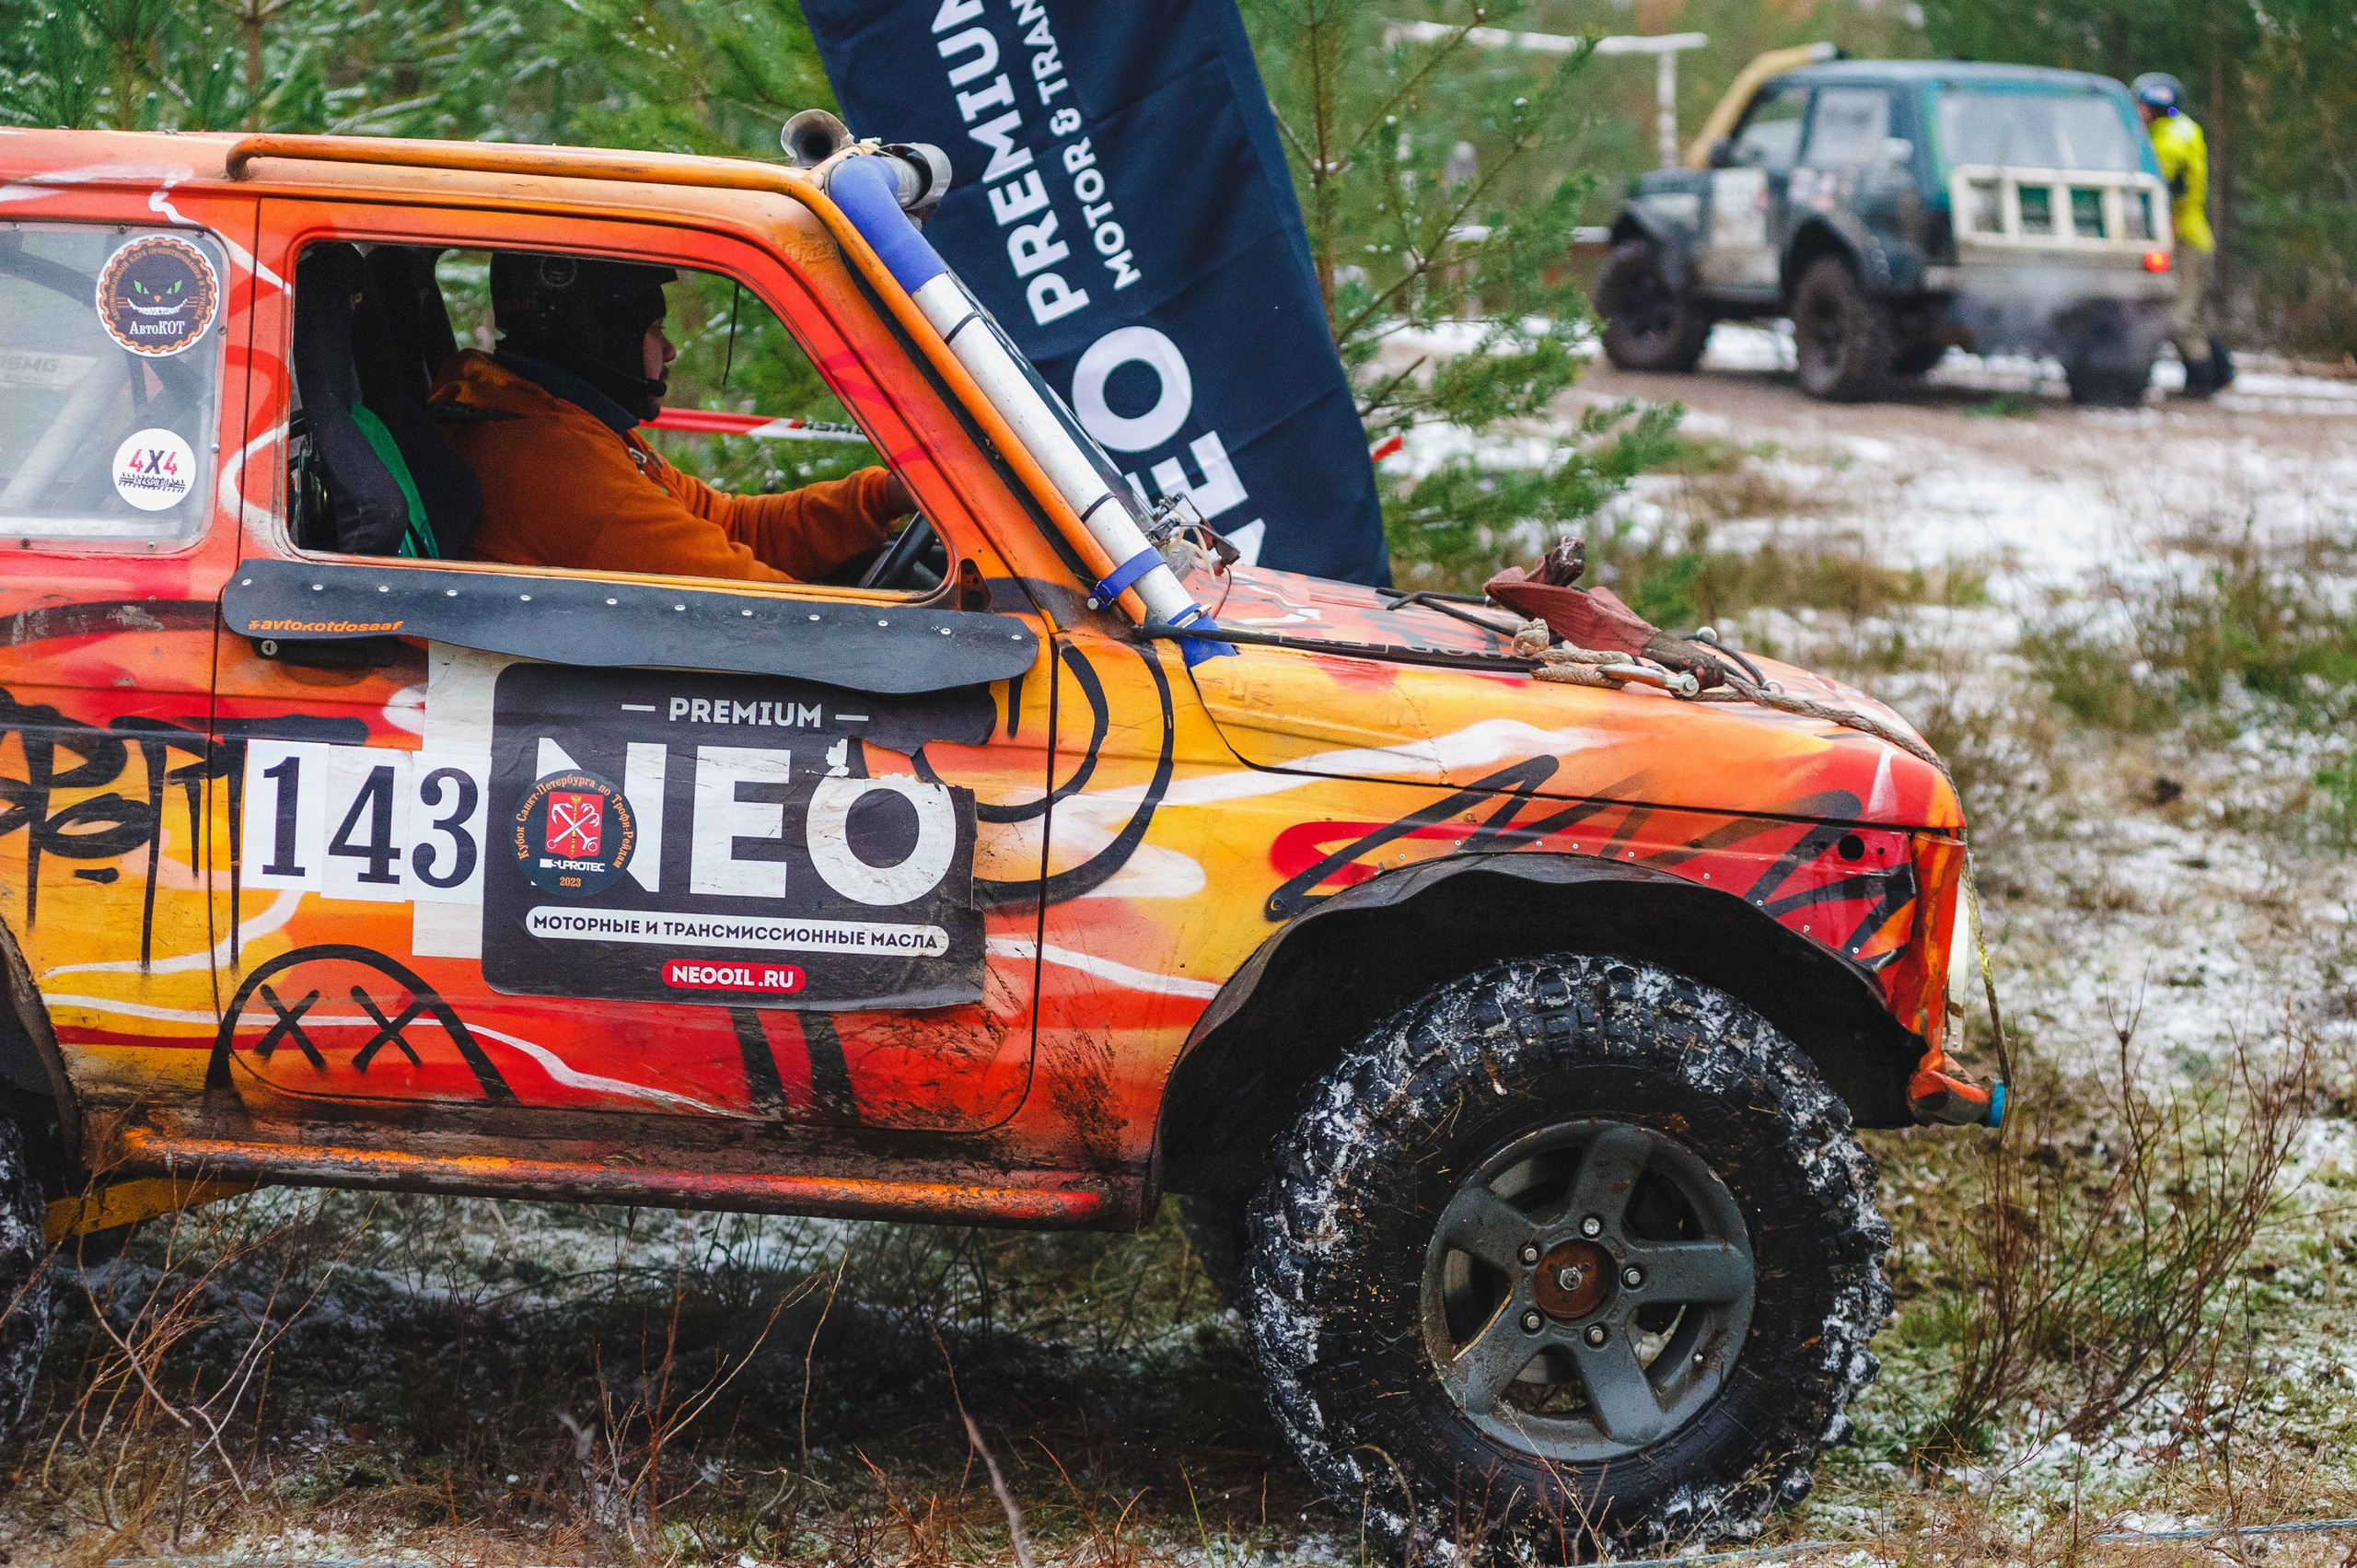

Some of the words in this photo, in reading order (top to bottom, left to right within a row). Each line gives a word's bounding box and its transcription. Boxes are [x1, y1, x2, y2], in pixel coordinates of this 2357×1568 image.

[1049, 107, 1083, 136] &
[1062, 136, 1143, 291] MOTOR
[129, 448, 178, 475] 4X4
[1072, 326, 1265, 565] EO
[248, 619, 403, 633] #avtokotdosaaf
[669, 697, 821, 727] PREMIUM
[516, 773, 597, 822] Санкт-Петербурга
[598, 783, 611, 796] по
[261, 755, 478, 889] 143
[610, 794, 634, 869] Трофи-Рейдам
[514, 826, 529, 860] Кубок
[559, 876, 582, 888] 2023
[533, 914, 640, 935] МОТОРНЫЕ
[645, 921, 659, 935] И
[664, 922, 865, 946] ТРАНСМИССИОННЫЕ
[871, 933, 938, 949] МАСЛА
